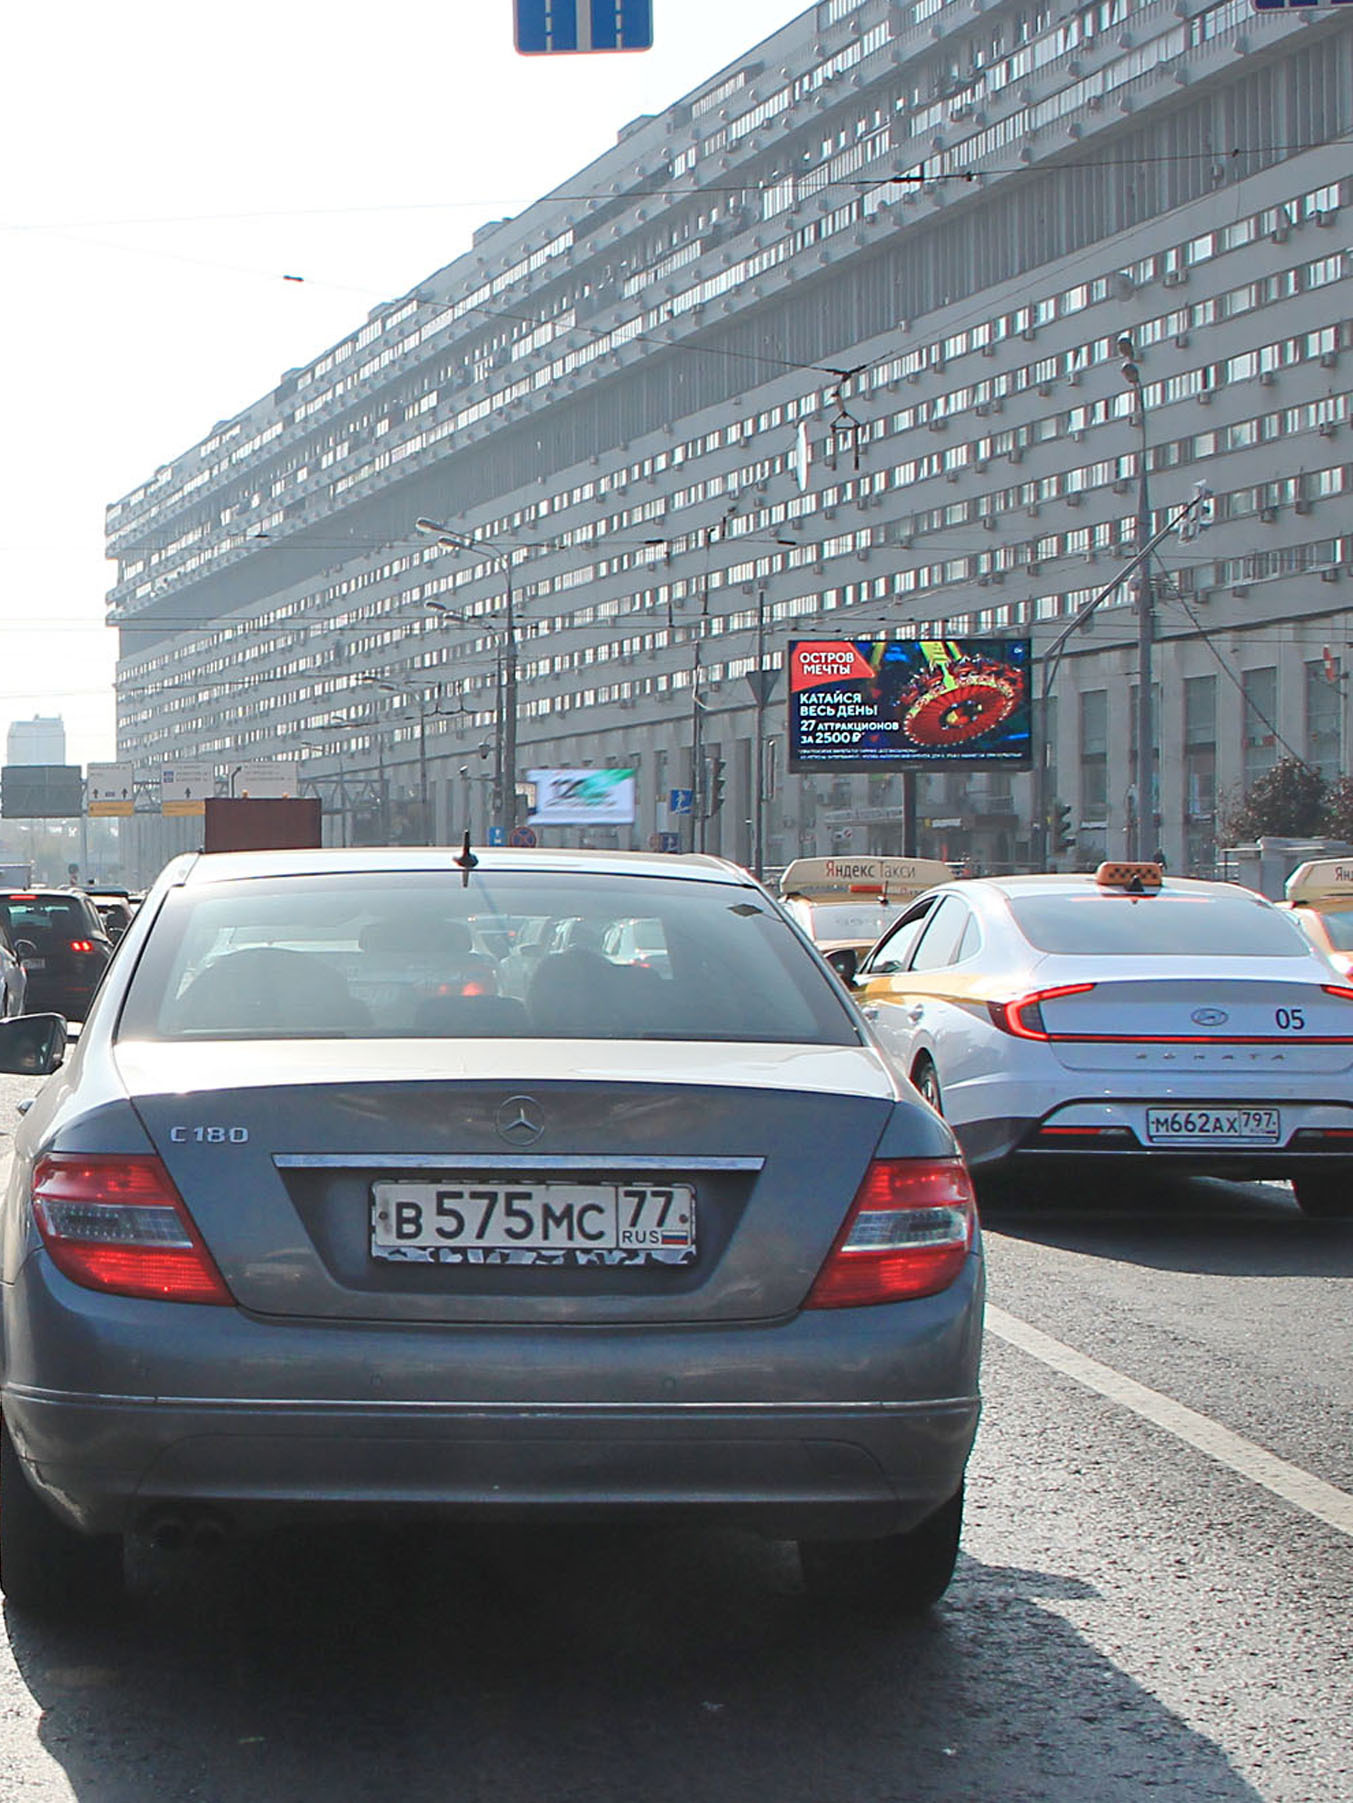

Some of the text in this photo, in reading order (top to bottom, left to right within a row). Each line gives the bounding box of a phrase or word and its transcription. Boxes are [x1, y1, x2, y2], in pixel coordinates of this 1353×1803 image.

[799, 652, 855, 663] ОСТРОВ
[802, 664, 851, 675] МЕЧТЫ
[799, 690, 862, 704] КАТАЙСЯ
[799, 705, 836, 716] ВЕСЬ
[800, 720, 899, 732] 27 АТТРАКЦИОНОВ
[800, 735, 814, 744] ЗА
[815, 732, 851, 744] 2500
[825, 859, 916, 879] Яндекс Такси
[1275, 1008, 1305, 1030] 05
[1241, 1111, 1273, 1127] 797
[624, 1190, 675, 1228] 77
[622, 1229, 660, 1244] RUS
